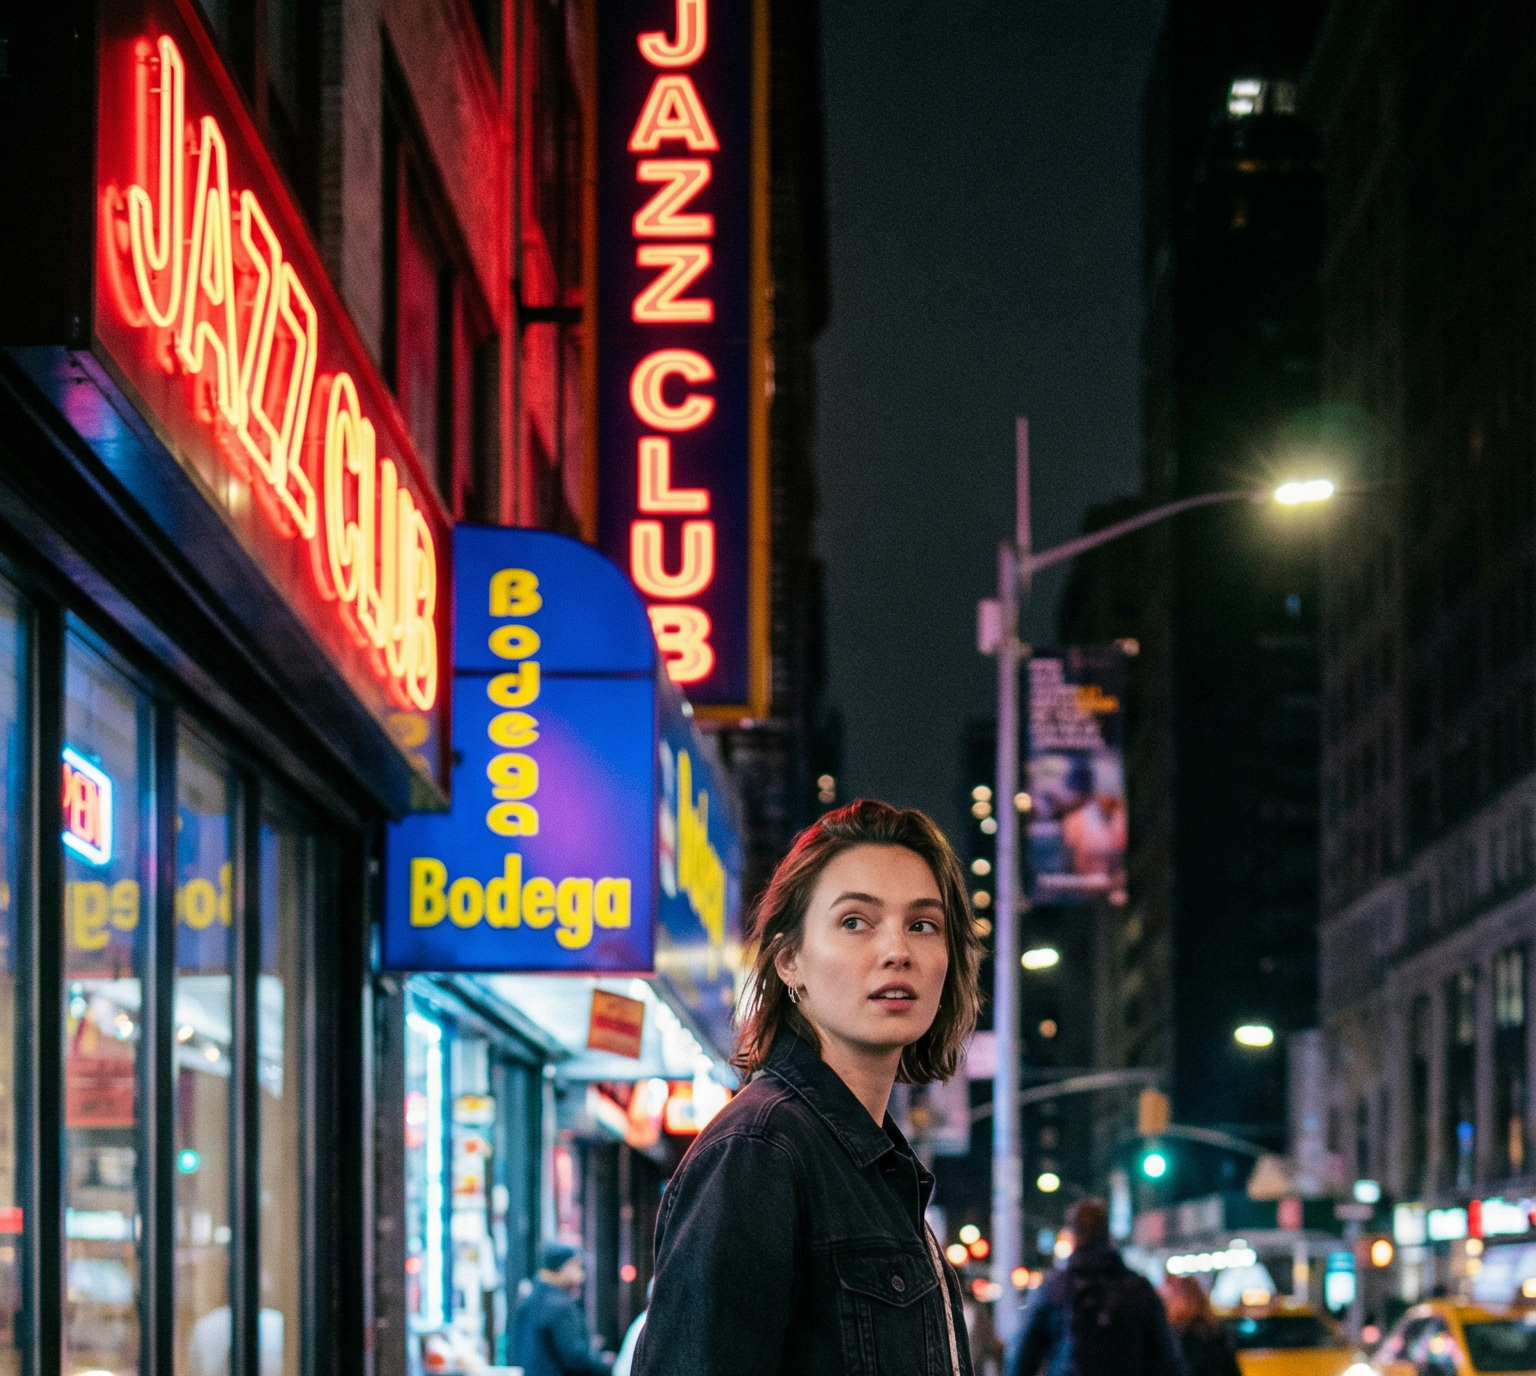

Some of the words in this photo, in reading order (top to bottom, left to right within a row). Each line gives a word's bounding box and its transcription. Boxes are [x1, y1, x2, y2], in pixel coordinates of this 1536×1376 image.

[629, 0, 720, 323] JAZZ
[129, 35, 318, 539] JAZZ
[323, 372, 438, 711] CLUB
[629, 348, 716, 683] CLUB
[486, 567, 543, 837] Bodega
[409, 854, 632, 950] Bodega
